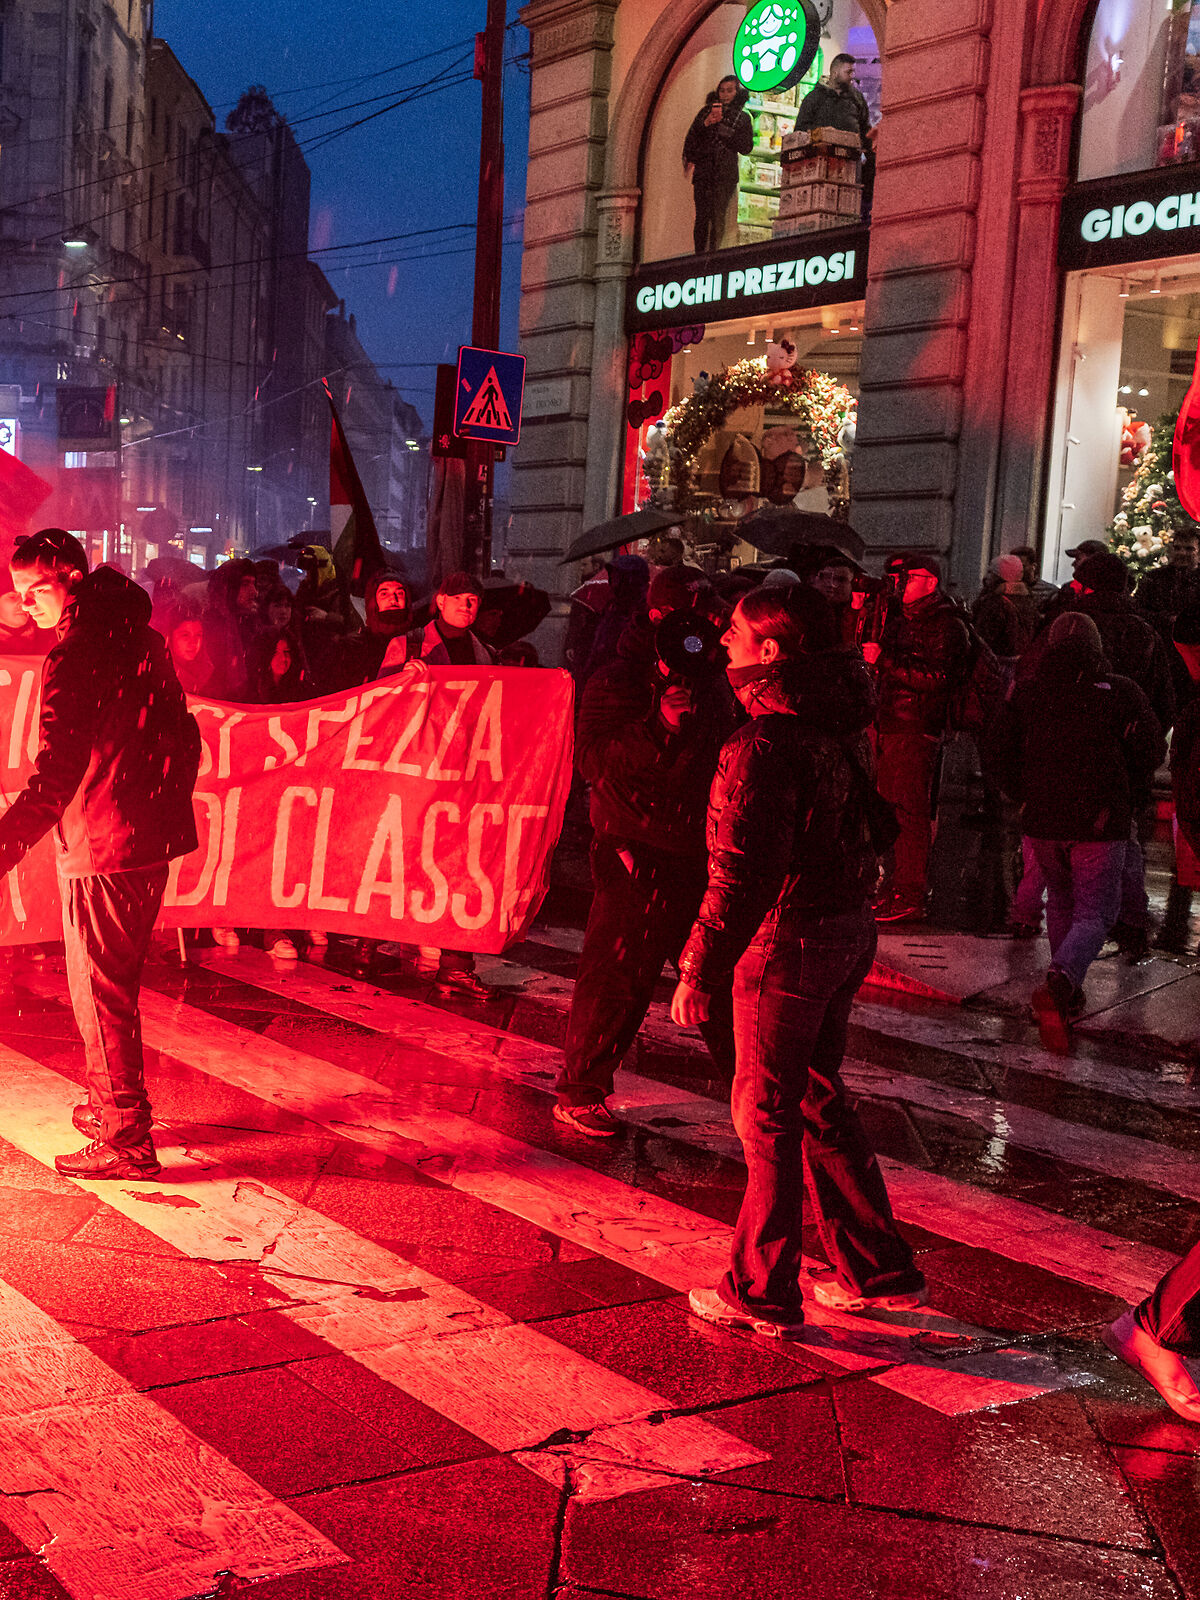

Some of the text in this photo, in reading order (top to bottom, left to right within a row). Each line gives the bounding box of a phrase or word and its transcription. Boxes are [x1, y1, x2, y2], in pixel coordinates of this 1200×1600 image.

[1081, 191, 1200, 242] GIOCH
[636, 250, 856, 313] GIOCHI PREZIOSI
[264, 680, 504, 782] SPEZZA
[163, 787, 241, 907] DI
[271, 786, 549, 933] CLASSE
